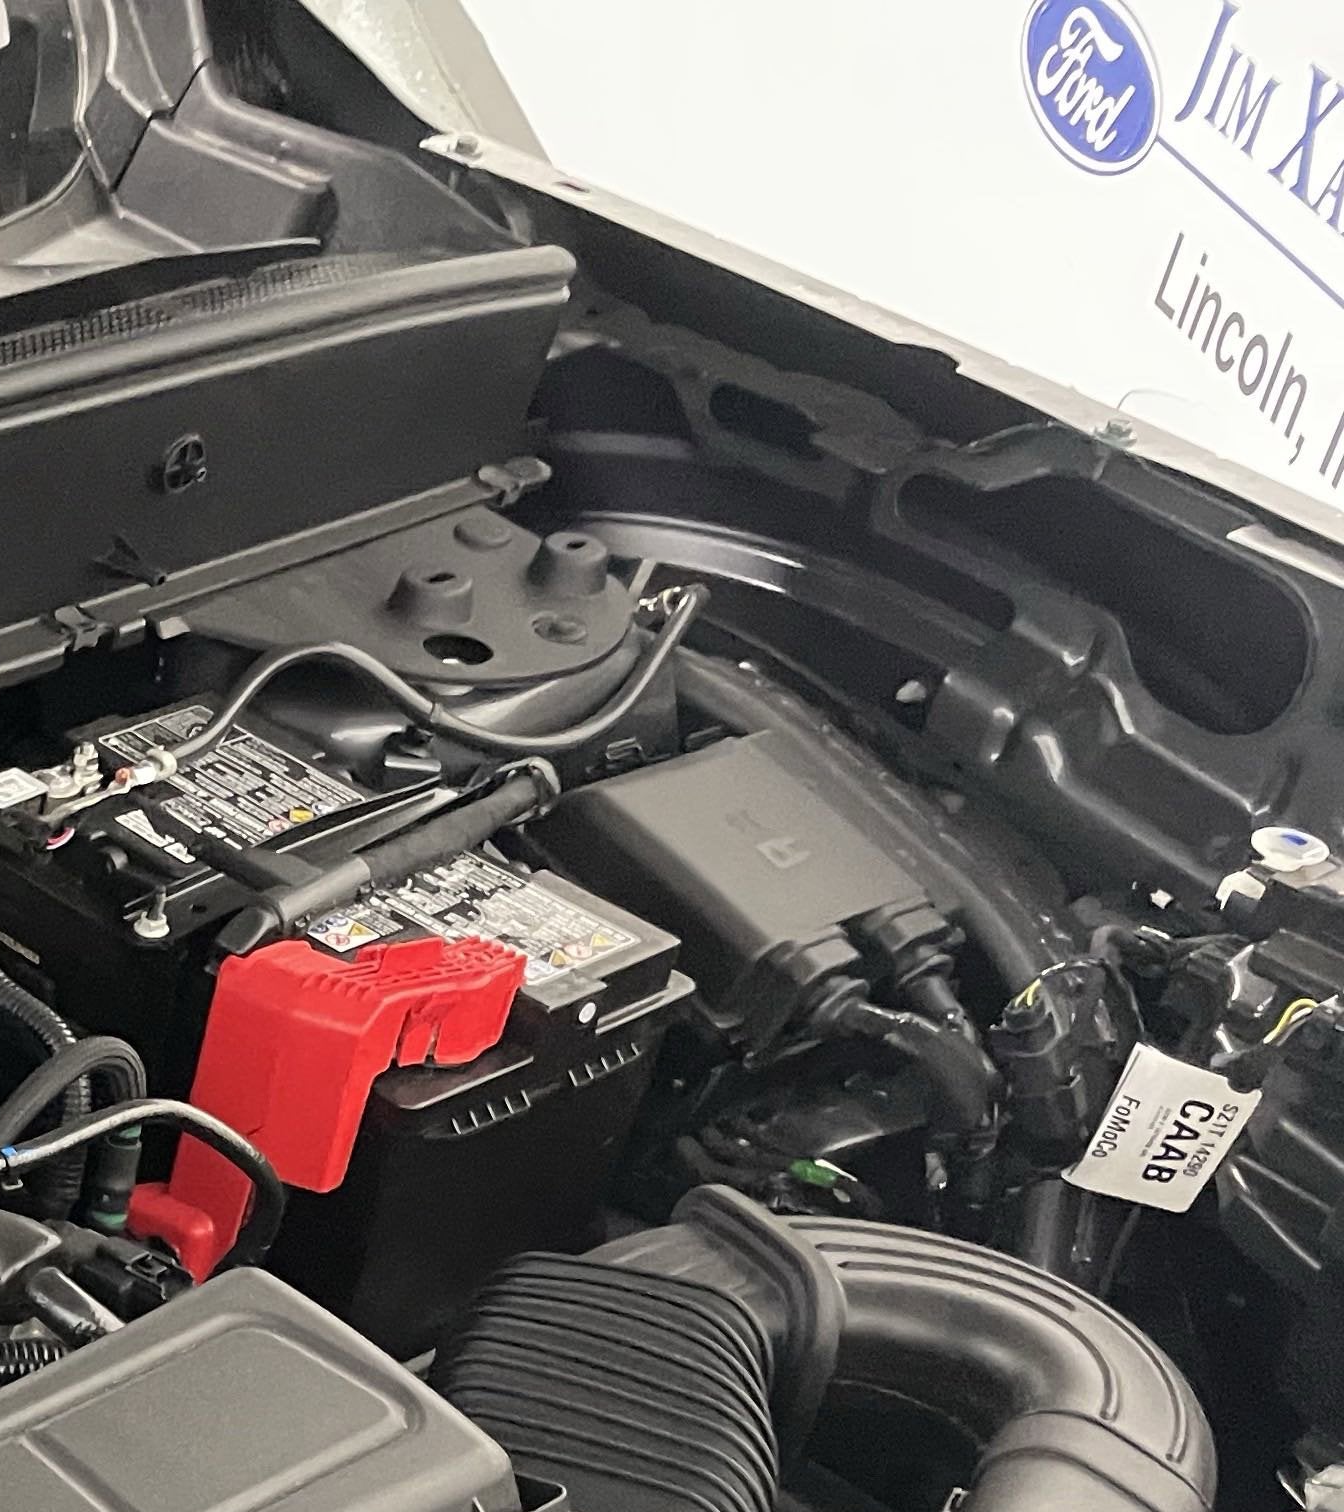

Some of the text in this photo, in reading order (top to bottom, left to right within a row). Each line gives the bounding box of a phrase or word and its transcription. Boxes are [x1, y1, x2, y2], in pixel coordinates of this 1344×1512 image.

[1036, 6, 1136, 152] Ford
[1267, 60, 1344, 238] XA
[1154, 231, 1306, 466] Lincoln,
[1142, 1099, 1214, 1184] CAAB
